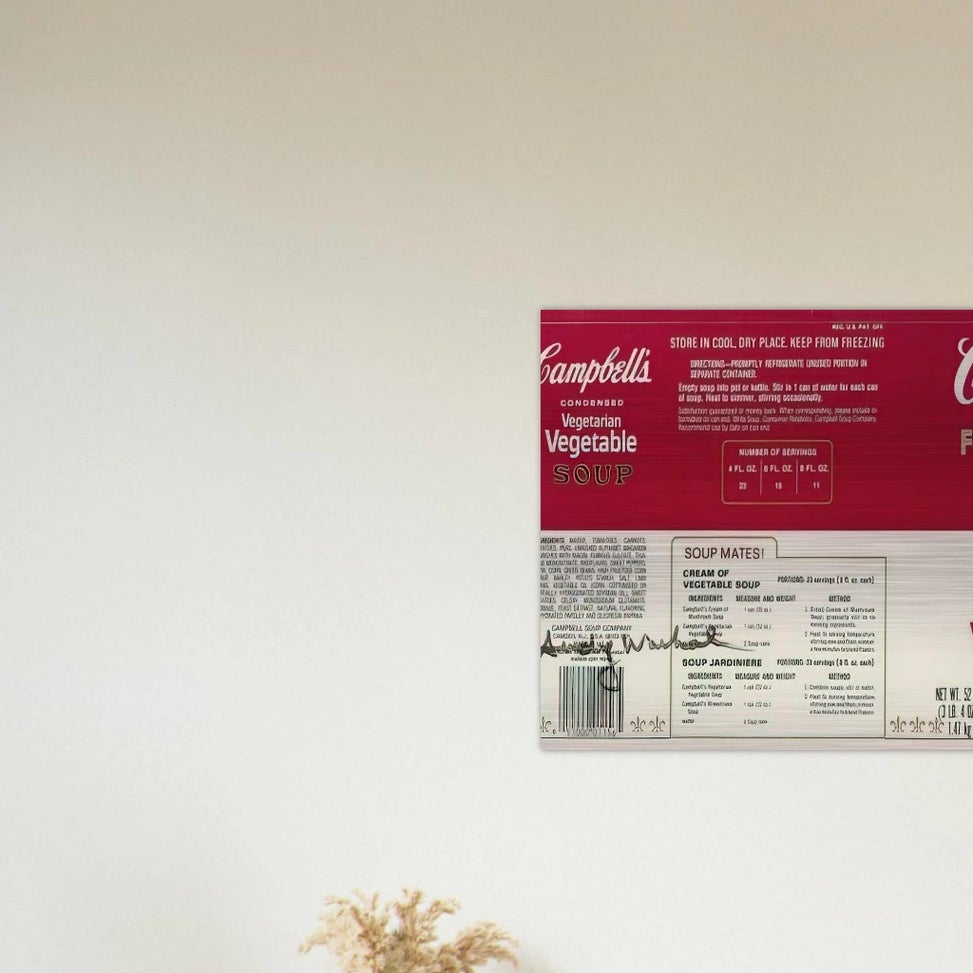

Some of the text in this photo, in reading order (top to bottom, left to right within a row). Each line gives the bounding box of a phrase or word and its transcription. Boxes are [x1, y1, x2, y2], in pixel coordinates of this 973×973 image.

[670, 337, 697, 348] STORE
[700, 337, 709, 348] IN
[739, 337, 756, 348] DRY
[790, 337, 812, 348] KEEP
[815, 337, 838, 348] FROM
[841, 337, 885, 348] FREEZING
[540, 342, 652, 394] Campbell's
[560, 399, 624, 407] CONDENSED
[561, 413, 622, 430] Vegetarian
[545, 429, 637, 458] Vegetable
[770, 448, 780, 456] OF
[553, 464, 634, 485] SOUP
[684, 547, 764, 559] SOUP MATES!
[682, 659, 762, 667] SOUP JARDINIERE
[936, 688, 947, 701] NET
[949, 688, 961, 701] WT.
[948, 704, 958, 718] LB.
[960, 704, 965, 718] 4
[948, 721, 972, 739] 1.47 kg
